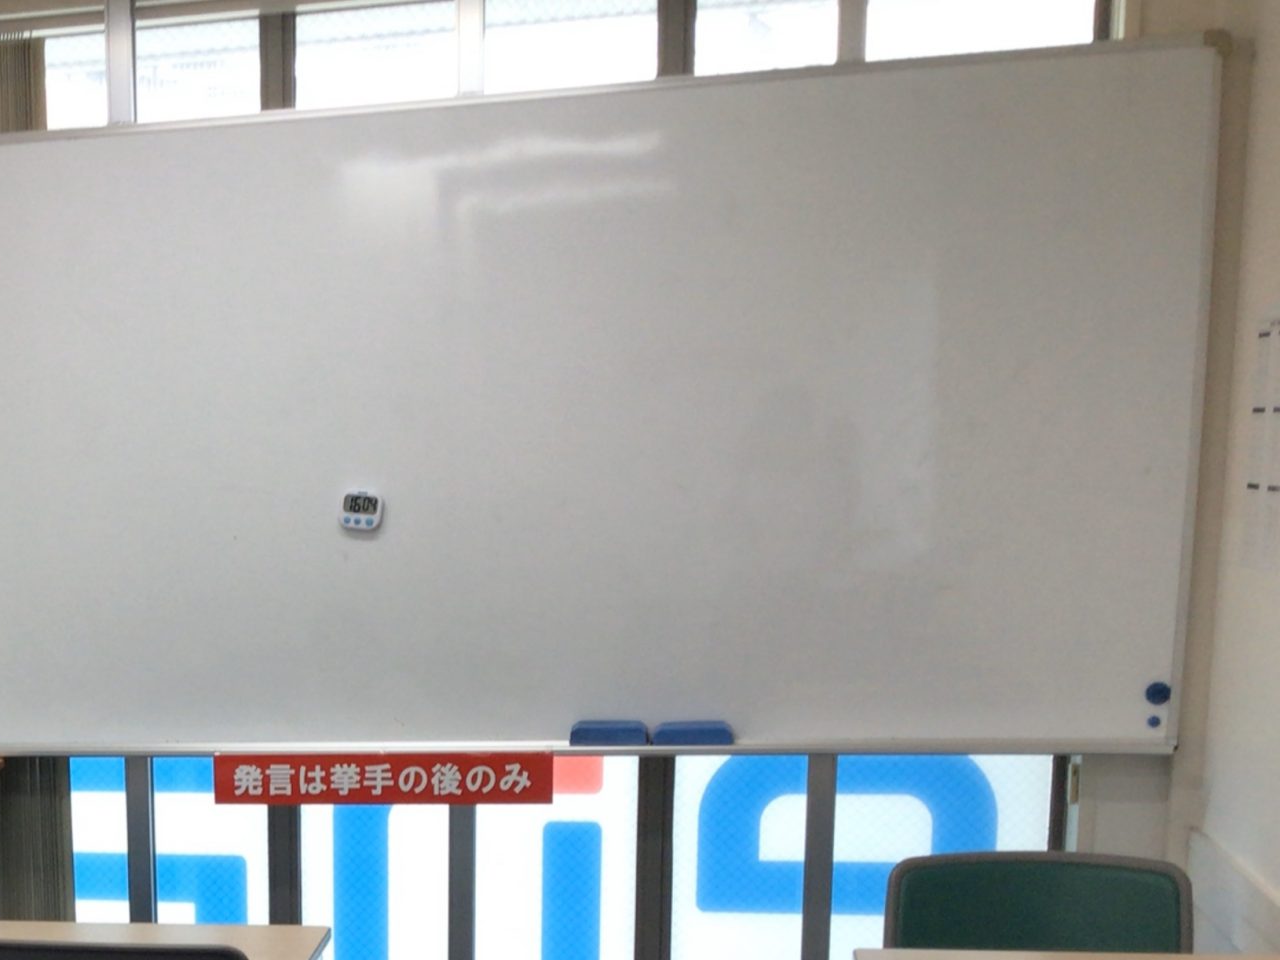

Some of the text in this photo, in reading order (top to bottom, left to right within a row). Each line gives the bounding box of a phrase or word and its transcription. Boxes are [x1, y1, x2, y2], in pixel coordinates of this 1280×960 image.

[234, 763, 532, 796] 発言は挙手の後のみ
